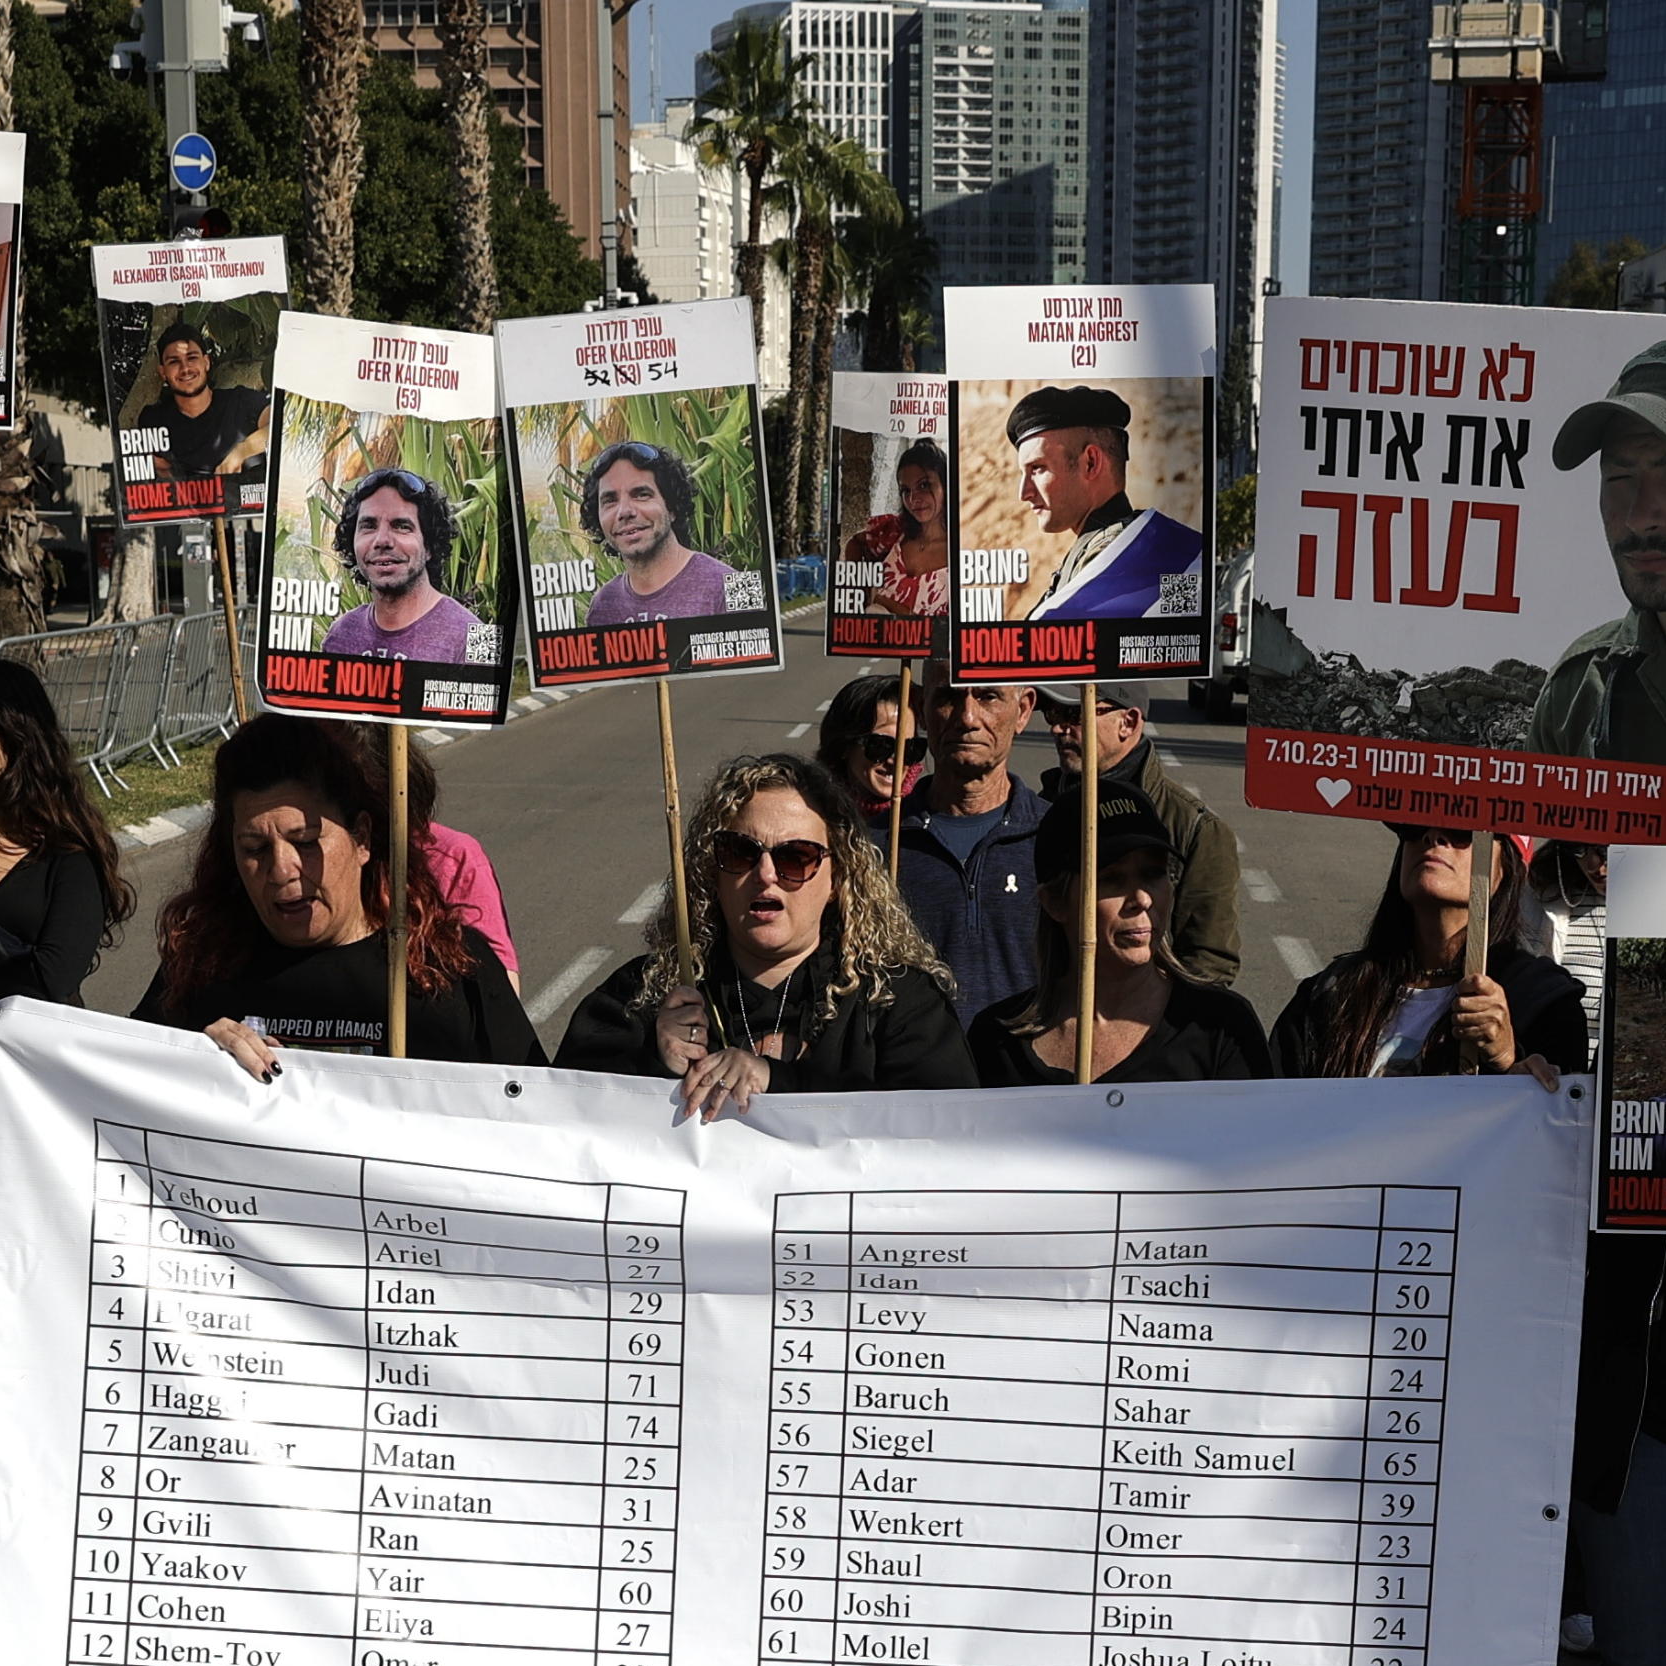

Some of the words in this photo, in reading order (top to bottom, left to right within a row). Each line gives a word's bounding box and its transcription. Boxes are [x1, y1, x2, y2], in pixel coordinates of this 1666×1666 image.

[113, 268, 167, 284] ALEXANDER
[169, 265, 208, 282] (SASHA)
[210, 262, 264, 278] TROUFANOV
[181, 282, 201, 298] (28)
[1043, 298, 1093, 319] אנגרסט
[1097, 297, 1122, 319] מתן
[1028, 322, 1074, 342] MATAN
[1078, 321, 1138, 342] ANGREST
[373, 336, 417, 362] קלדרון
[421, 342, 448, 365] עופר
[576, 343, 607, 366] OFER
[610, 338, 677, 362] KALDERON
[1071, 344, 1096, 368] (21)
[358, 359, 391, 383] OFER
[395, 364, 459, 390] KALDERON
[648, 361, 678, 381] 54
[1300, 338, 1465, 399] שוכחים
[1479, 343, 1535, 402] לא
[396, 387, 421, 411] (53)
[890, 401, 931, 414] DANIELA
[1300, 405, 1424, 482] איתי
[1441, 414, 1531, 488] את
[1296, 489, 1520, 614] בעזה
[835, 561, 884, 588] BRING
[960, 549, 1028, 584] BRING
[271, 577, 340, 615] BRING
[835, 590, 865, 614] HER
[960, 588, 1003, 622] HIM
[268, 615, 313, 651] HIM
[960, 628, 1023, 663] HOME
[1031, 621, 1096, 660] NOW!
[1119, 635, 1154, 648] HOSTAGES
[1155, 635, 1169, 647] AND
[1171, 634, 1200, 646] MISSING
[1119, 648, 1163, 664] FAMILIES
[1165, 646, 1199, 663] FORUM
[1365, 751, 1427, 777] ונחטף
[1433, 754, 1481, 784] בקרב
[1490, 757, 1526, 786] נפל
[1586, 769, 1607, 798] חן
[1617, 773, 1660, 800] איתי
[315, 1020, 333, 1037] BY
[336, 1020, 382, 1040] HAMAS
[780, 1339, 815, 1364] 54
[854, 1342, 946, 1370] Gonen
[1114, 1355, 1190, 1383] Romi
[1388, 1368, 1424, 1394] 24
[100, 1464, 116, 1490] 8
[145, 1468, 182, 1494] Or
[368, 1483, 494, 1515] Avinatan
[621, 1497, 653, 1523] 31
